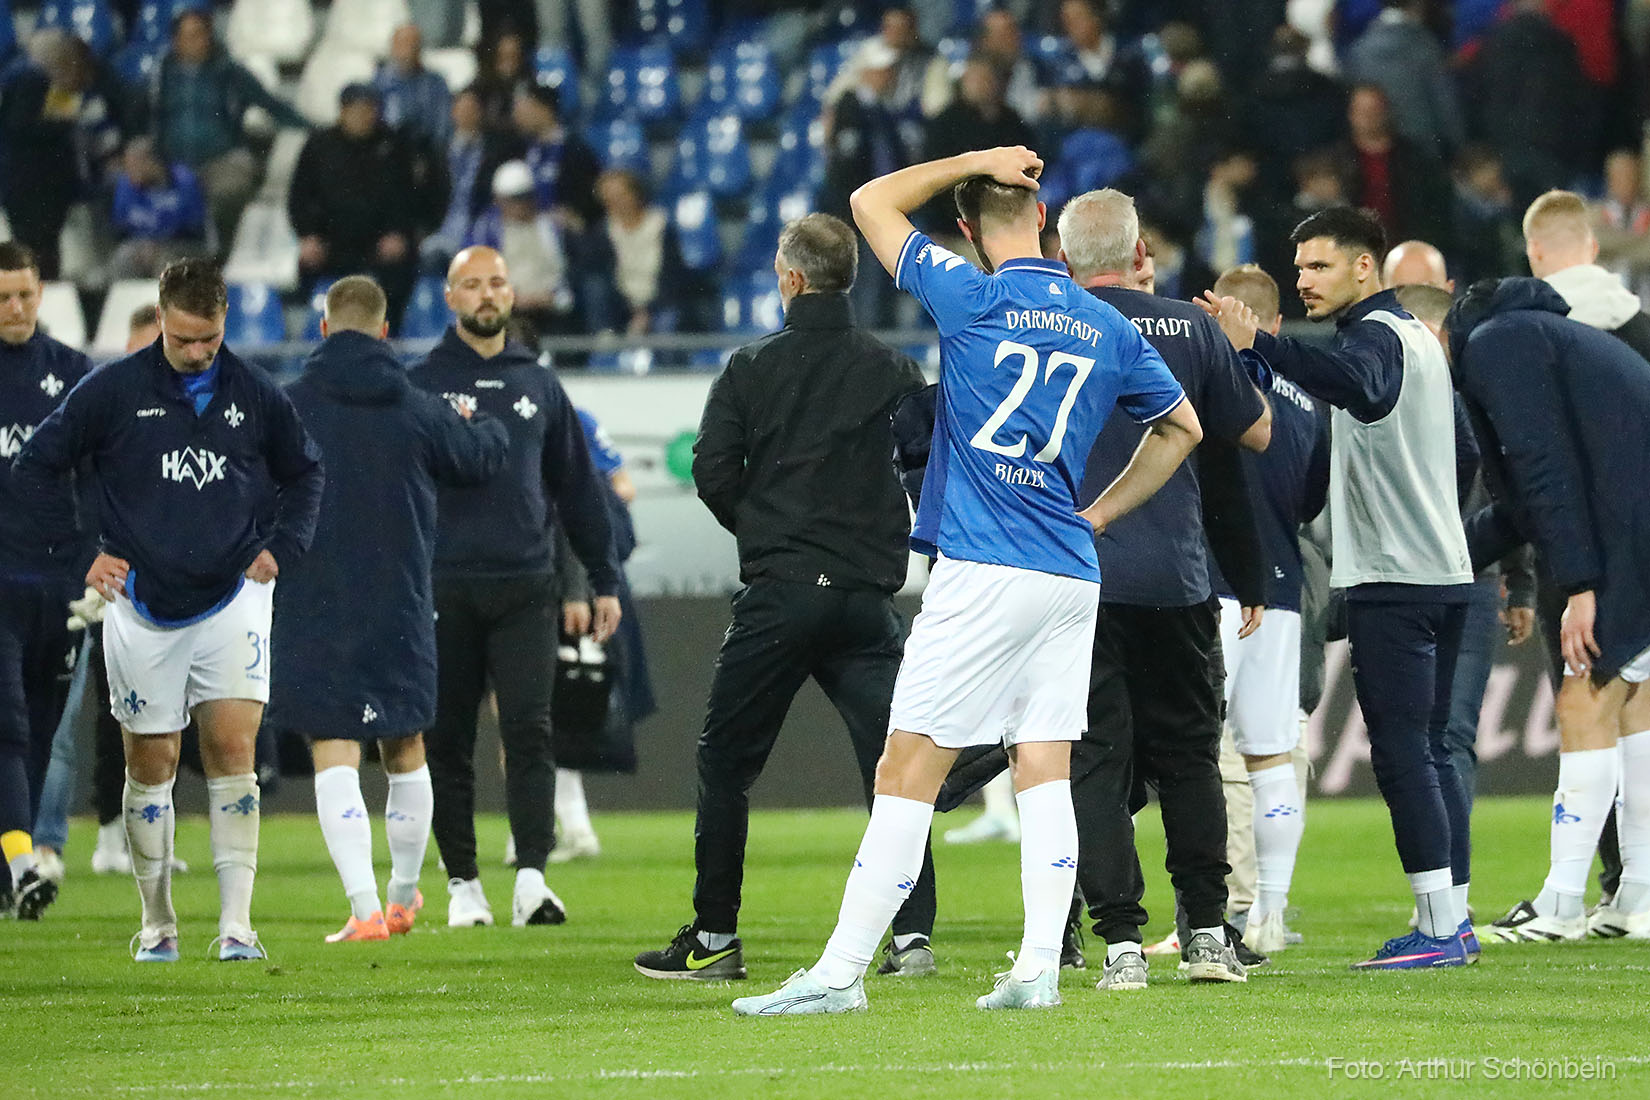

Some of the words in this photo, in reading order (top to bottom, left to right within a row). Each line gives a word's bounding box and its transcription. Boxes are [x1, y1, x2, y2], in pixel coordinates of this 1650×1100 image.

[1005, 310, 1102, 348] DARMSTADT
[1130, 317, 1192, 338] STADT
[969, 340, 1096, 464] 27
[995, 463, 1049, 489] BIALEK
